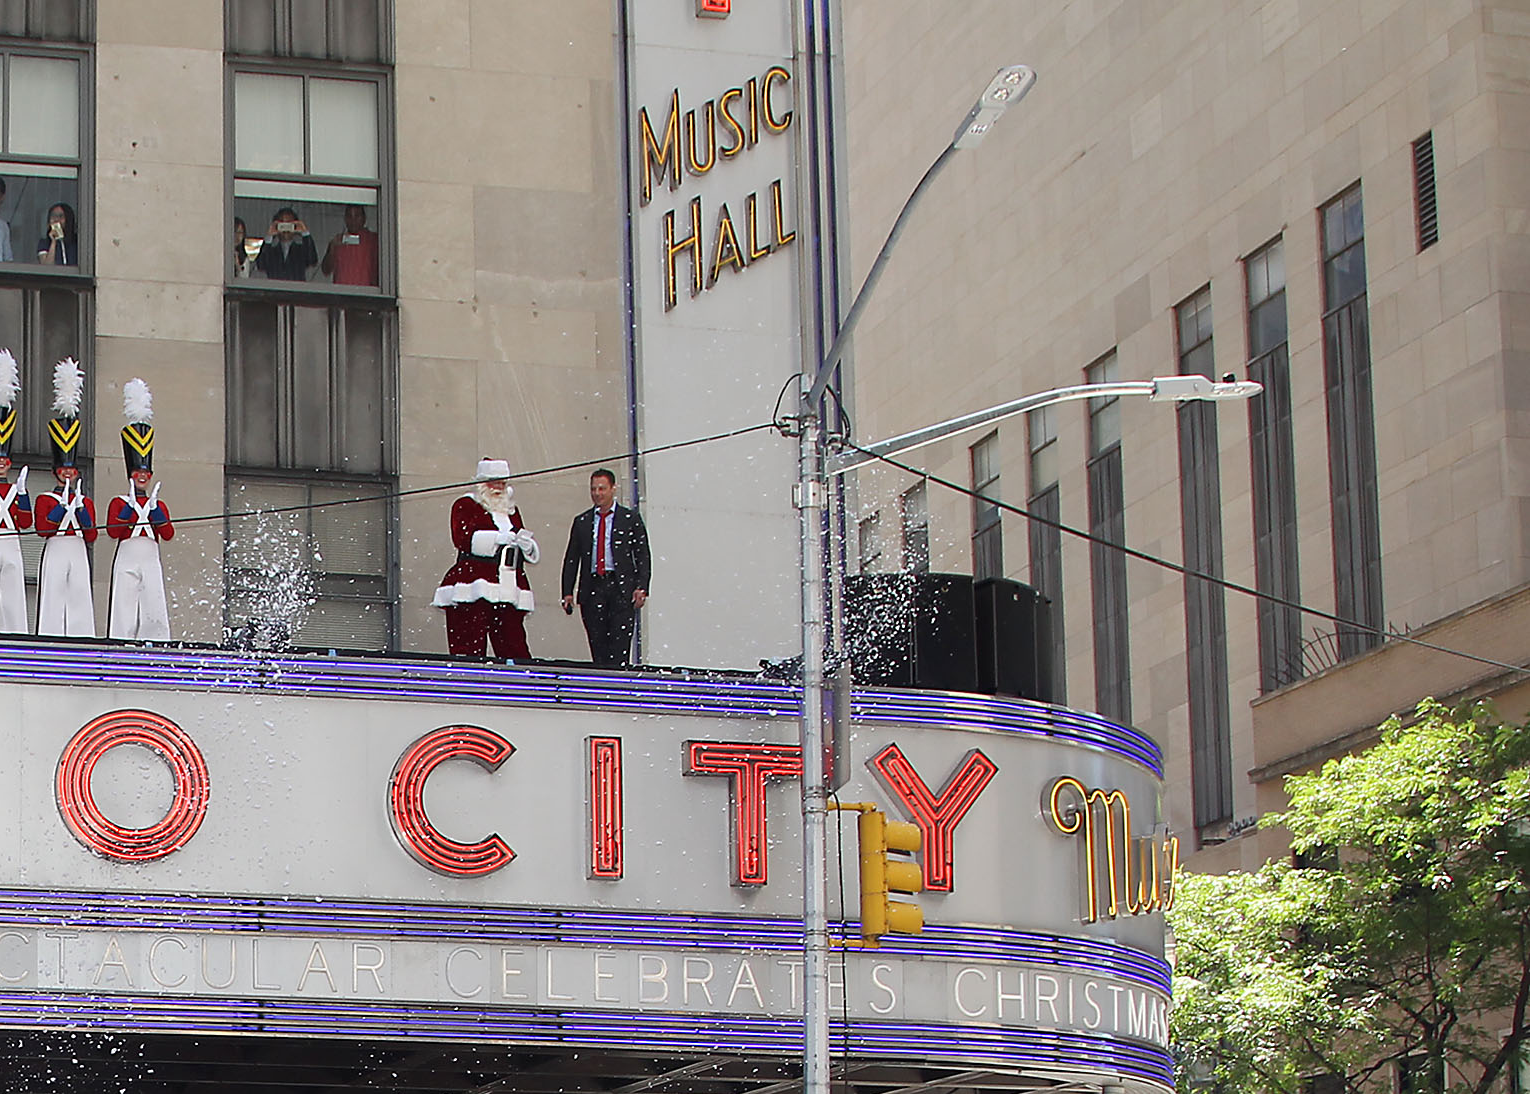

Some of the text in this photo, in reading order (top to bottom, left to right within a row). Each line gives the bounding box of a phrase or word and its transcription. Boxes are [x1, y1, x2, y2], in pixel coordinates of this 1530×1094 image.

[639, 66, 793, 208] MUSIC
[663, 179, 796, 313] HALL
[384, 724, 998, 893] CITY
[445, 946, 896, 1014] CELEBRATES
[955, 968, 1168, 1049] CHRISTMAS
